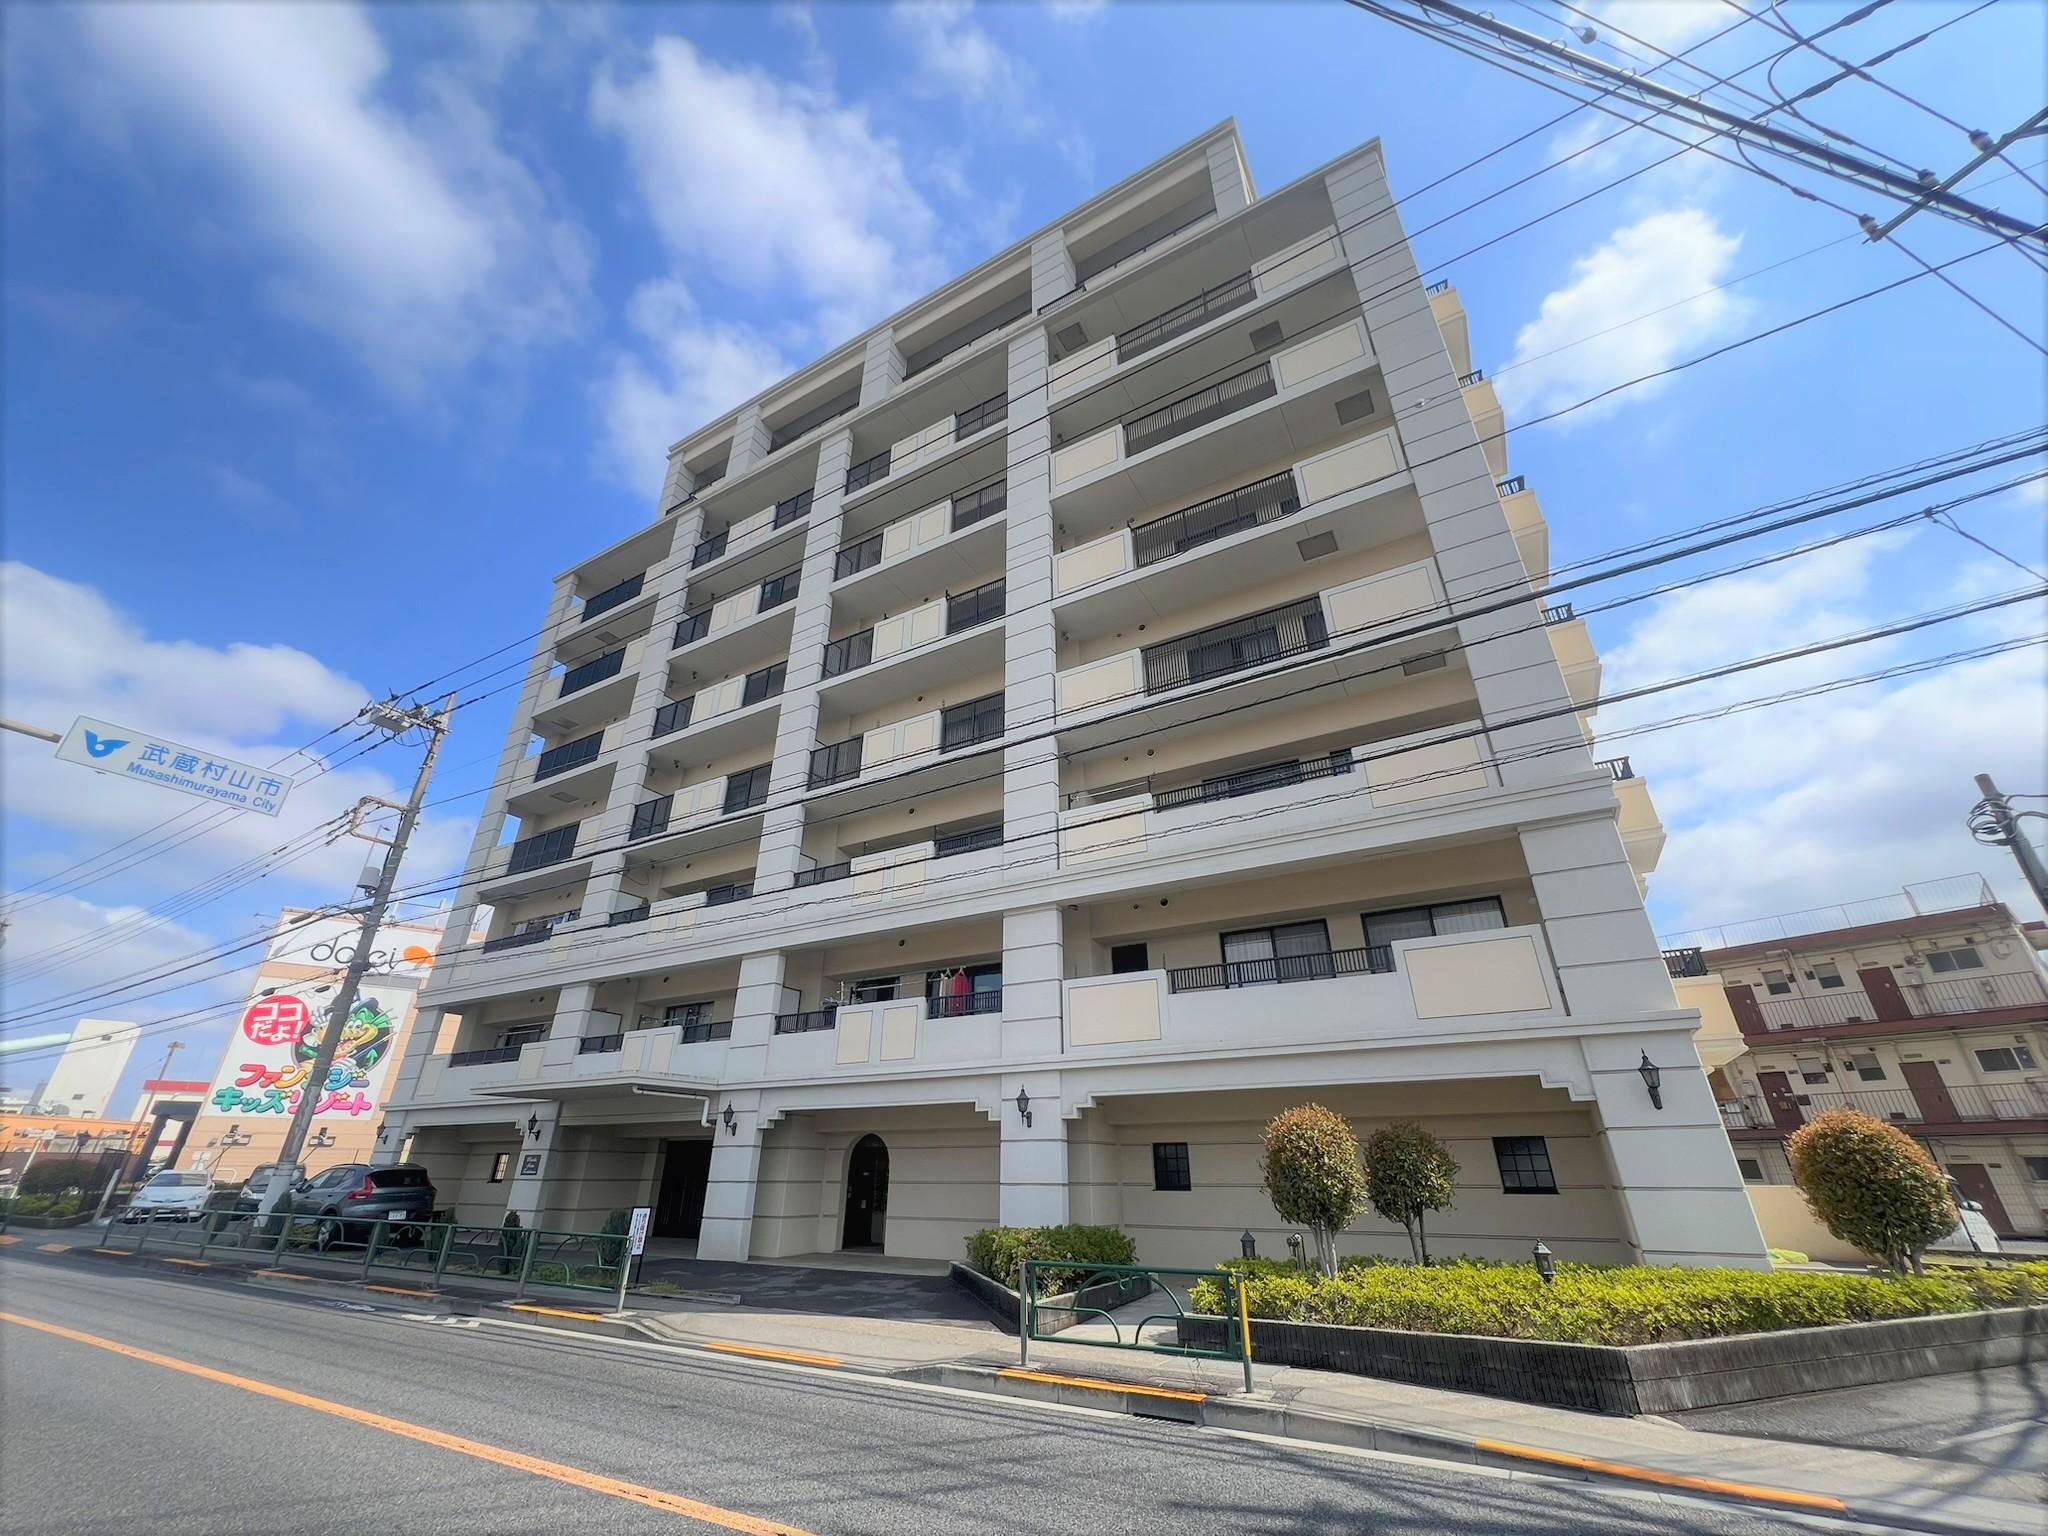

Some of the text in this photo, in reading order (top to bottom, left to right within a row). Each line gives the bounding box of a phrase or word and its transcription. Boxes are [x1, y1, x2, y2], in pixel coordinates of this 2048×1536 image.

[138, 743, 283, 797] 武蔵村山市
[127, 761, 276, 813] Musashimurayama City
[254, 1002, 304, 1021] ココ
[250, 1020, 304, 1041] だよ!
[234, 1063, 370, 1091] ファンジー
